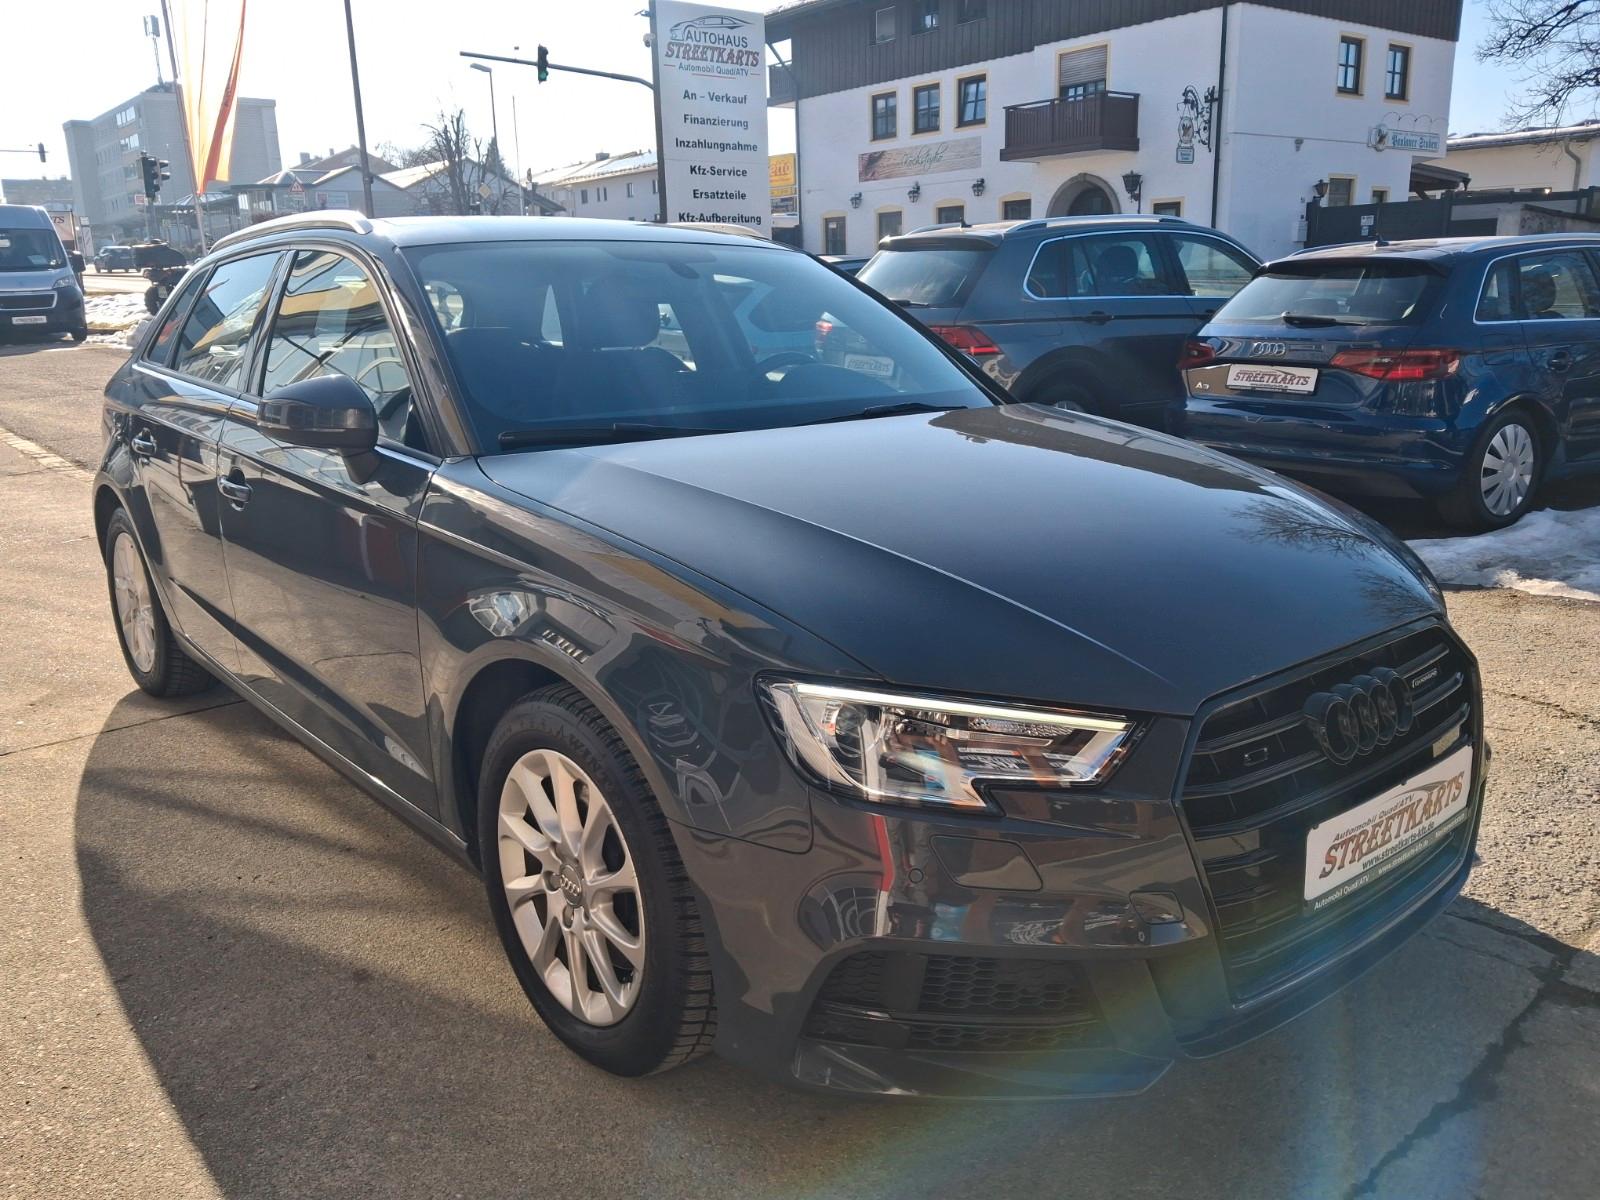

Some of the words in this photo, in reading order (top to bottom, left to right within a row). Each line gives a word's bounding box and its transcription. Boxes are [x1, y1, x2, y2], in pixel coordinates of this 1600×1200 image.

[685, 30, 748, 48] AUTOHAUS
[665, 42, 760, 67] STREETKARTS
[678, 62, 714, 73] Automobil
[683, 90, 697, 100] An
[708, 92, 748, 104] Verkauf
[684, 114, 749, 130] Finanzierung
[675, 138, 758, 152] Inzahlungnahme
[690, 165, 748, 177] Kfz-Service
[693, 189, 747, 200] Ersatzteile
[679, 212, 762, 225] Kfz-Aufbereitung
[1234, 372, 1310, 387] STREETKARTS
[1318, 771, 1465, 880] STREETKARTS
[1333, 813, 1378, 842] Automobil
